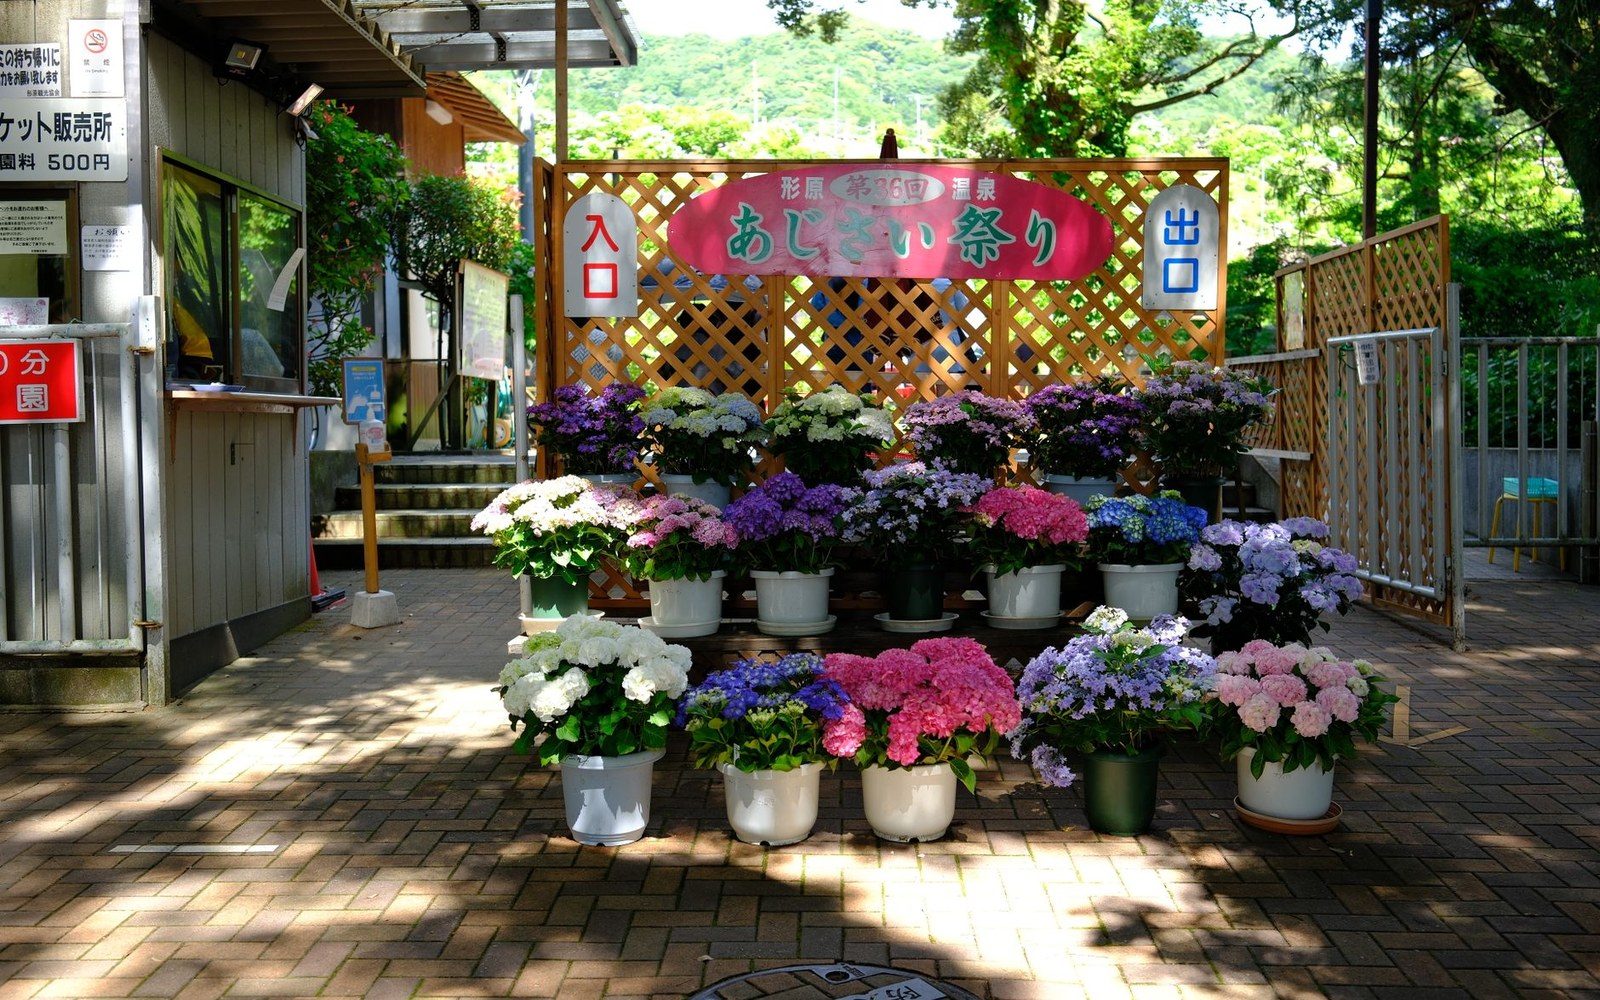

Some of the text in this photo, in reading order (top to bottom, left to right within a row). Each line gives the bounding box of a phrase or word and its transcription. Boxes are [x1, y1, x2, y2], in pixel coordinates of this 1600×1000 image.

[0, 111, 112, 142] ケット販売所
[0, 153, 110, 170] 園料 500円
[780, 175, 996, 200] 形原 第36回 温泉
[726, 202, 1057, 269] あじさい祭り
[1163, 208, 1200, 294] 出口
[581, 214, 619, 299] 入口
[17, 384, 49, 412] 園
